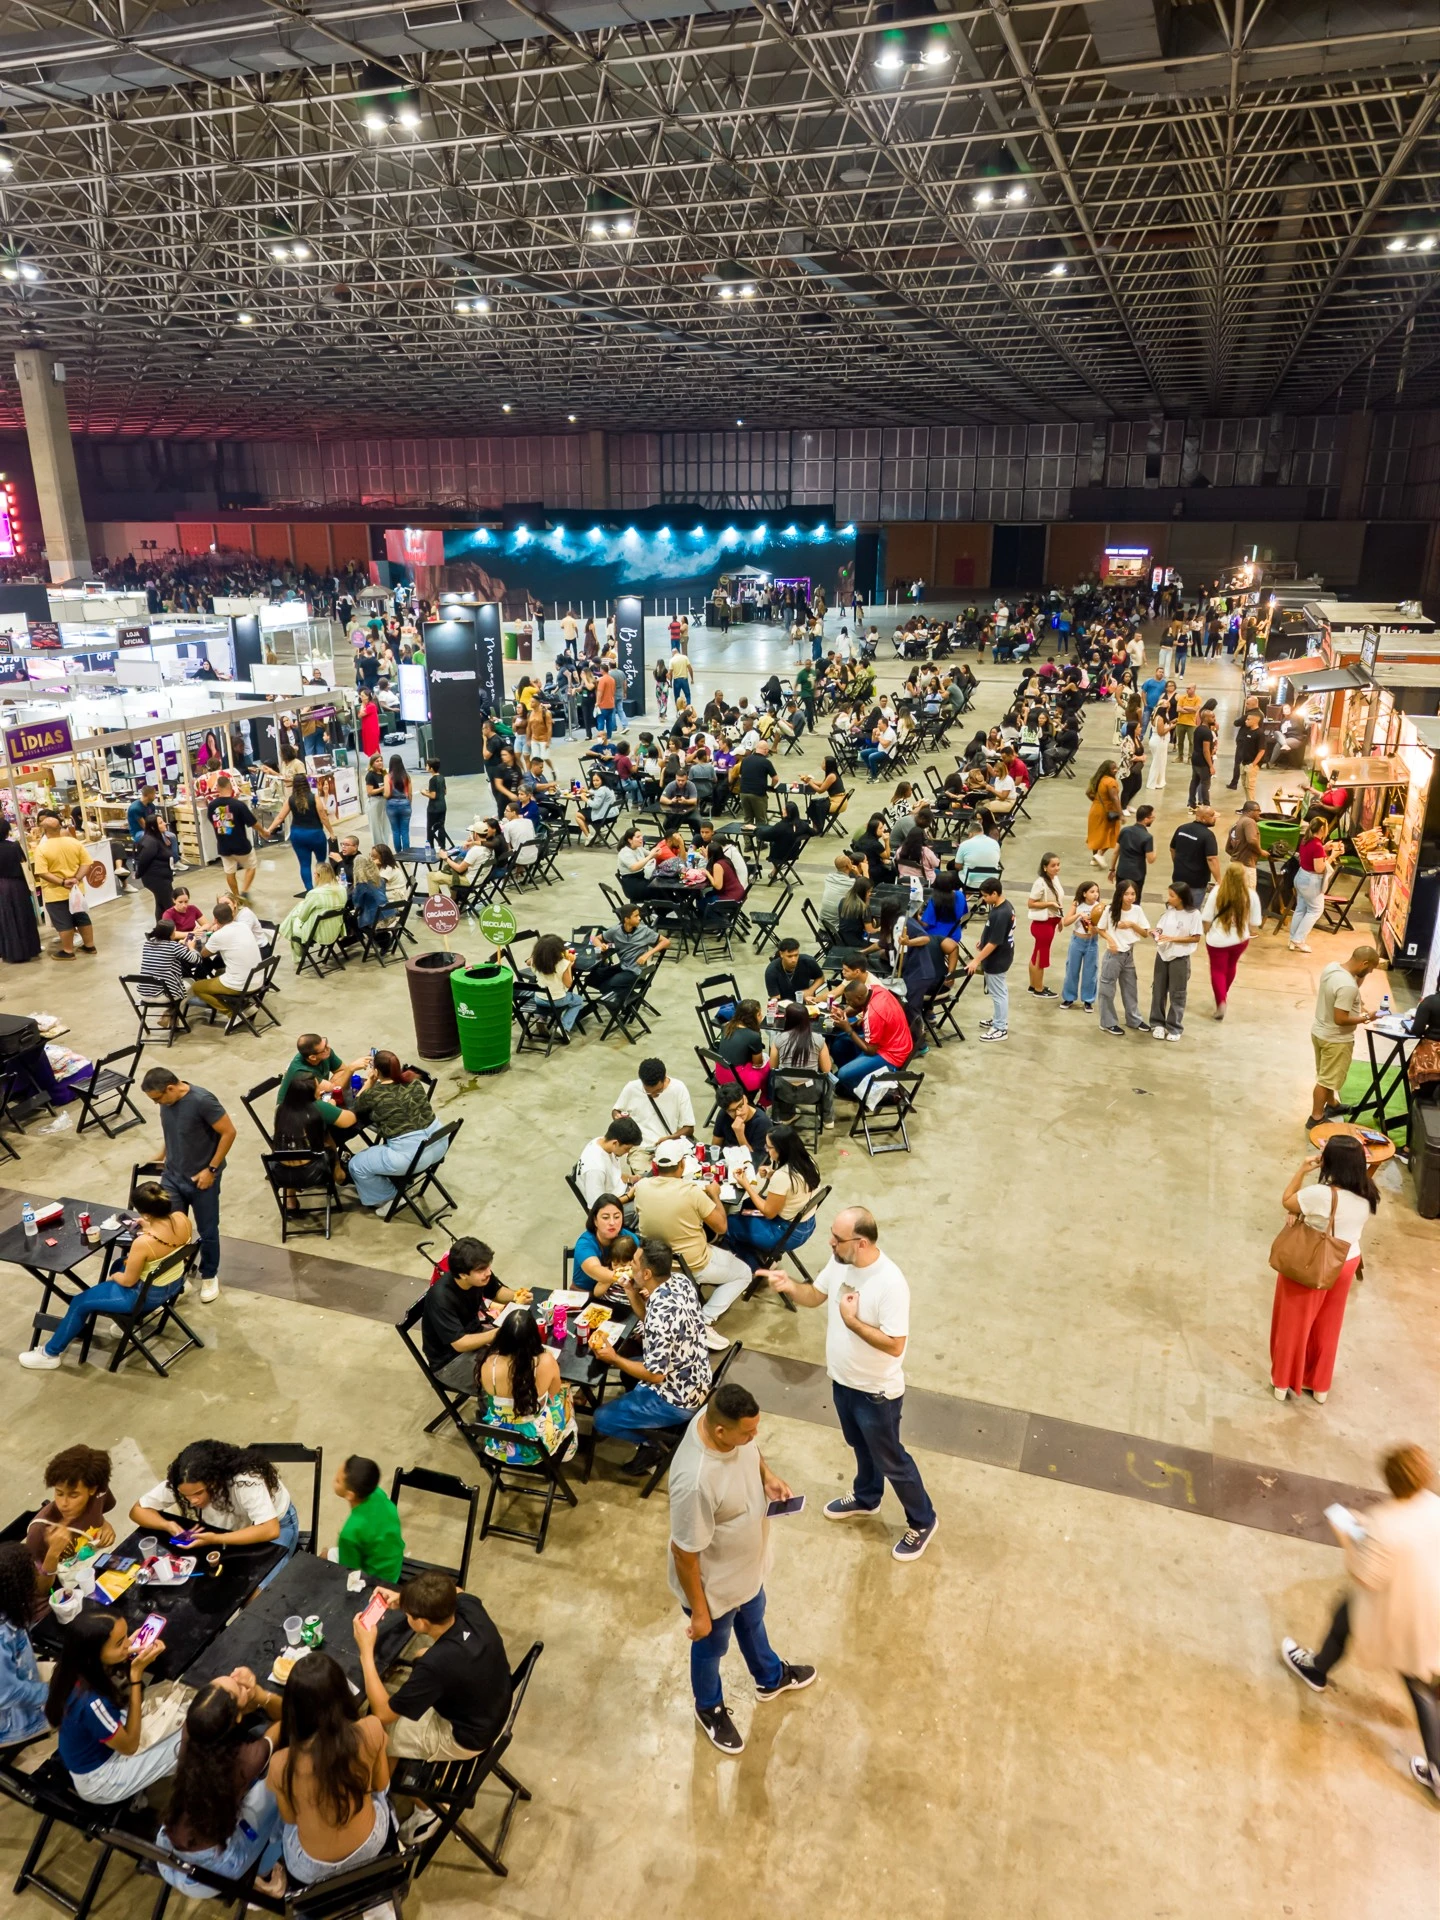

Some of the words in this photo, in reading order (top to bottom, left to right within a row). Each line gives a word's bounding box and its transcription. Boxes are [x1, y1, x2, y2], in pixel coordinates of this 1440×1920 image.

[618, 627, 638, 656] Bem
[97, 652, 112, 660] OFF
[427, 910, 455, 918] ORGÂNICO
